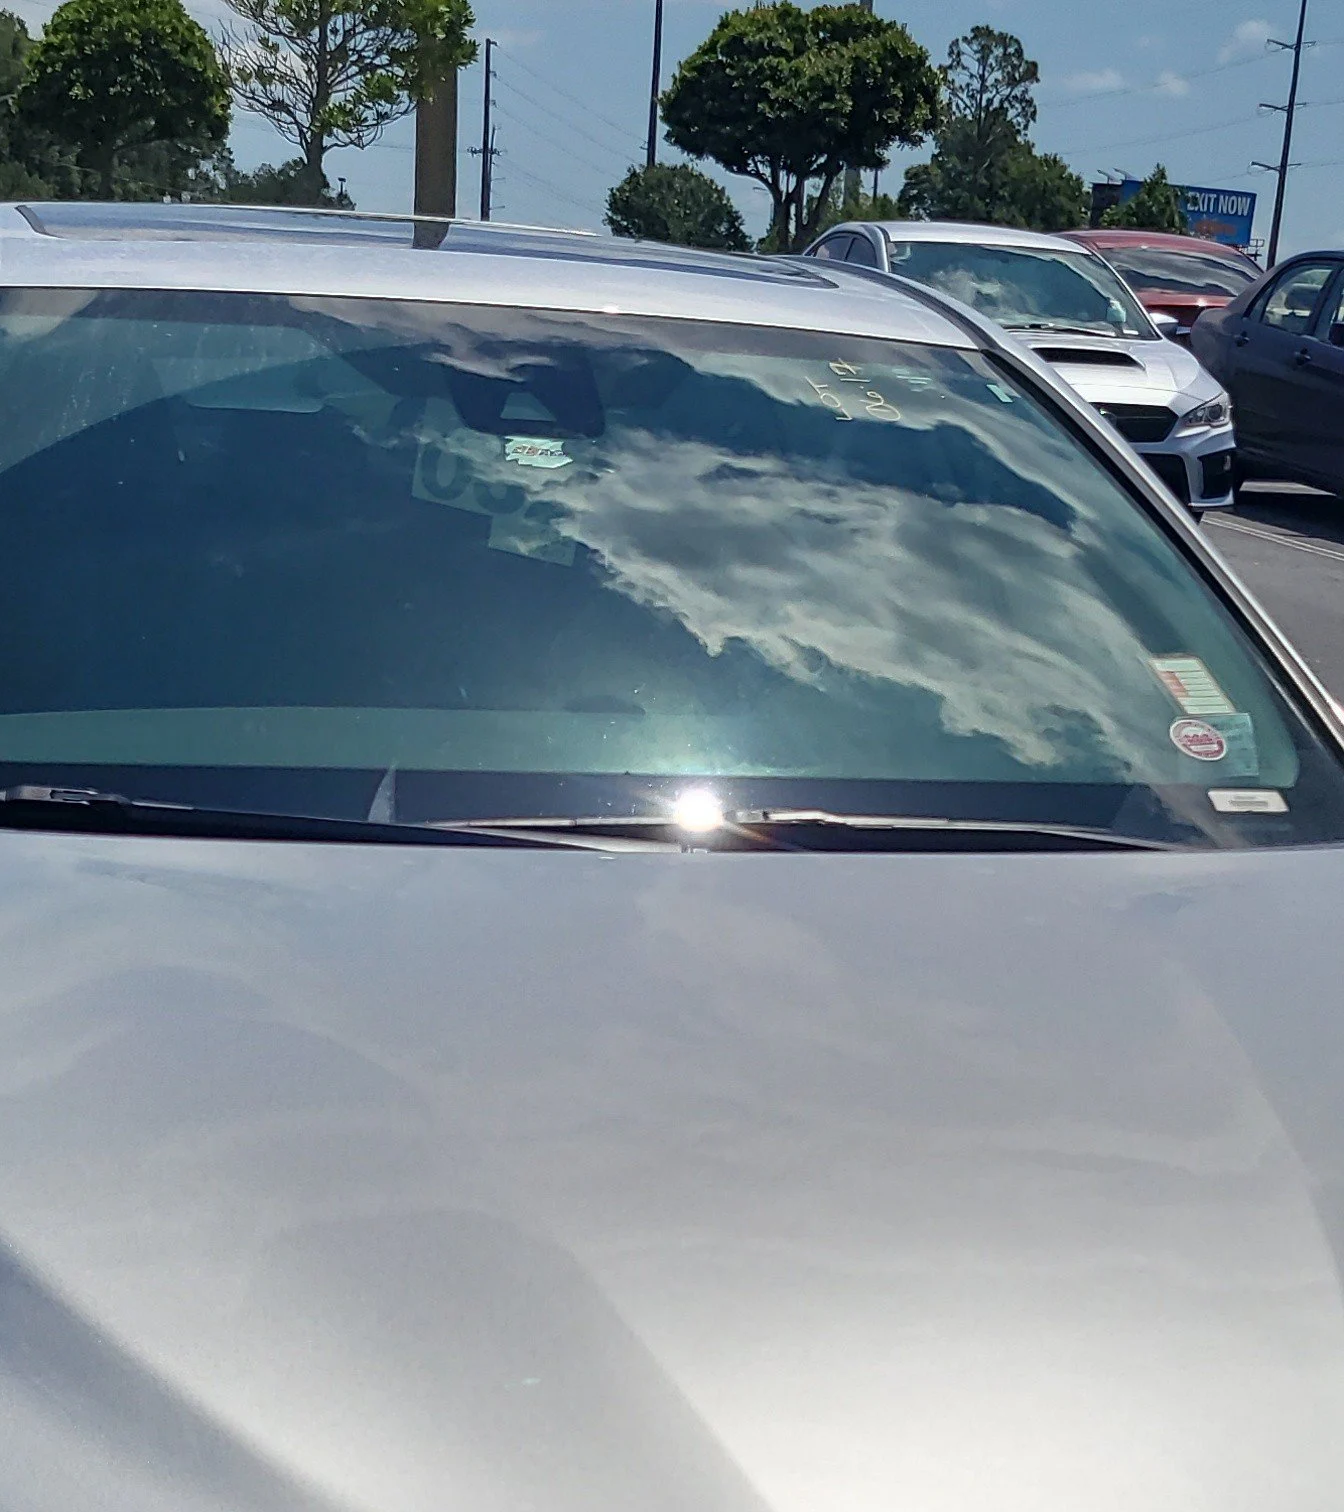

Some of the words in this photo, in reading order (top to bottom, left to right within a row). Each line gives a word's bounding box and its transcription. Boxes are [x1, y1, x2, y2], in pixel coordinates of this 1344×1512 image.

[1186, 191, 1217, 212] EXIT
[1218, 194, 1251, 216] NOW
[805, 376, 853, 421] LOT
